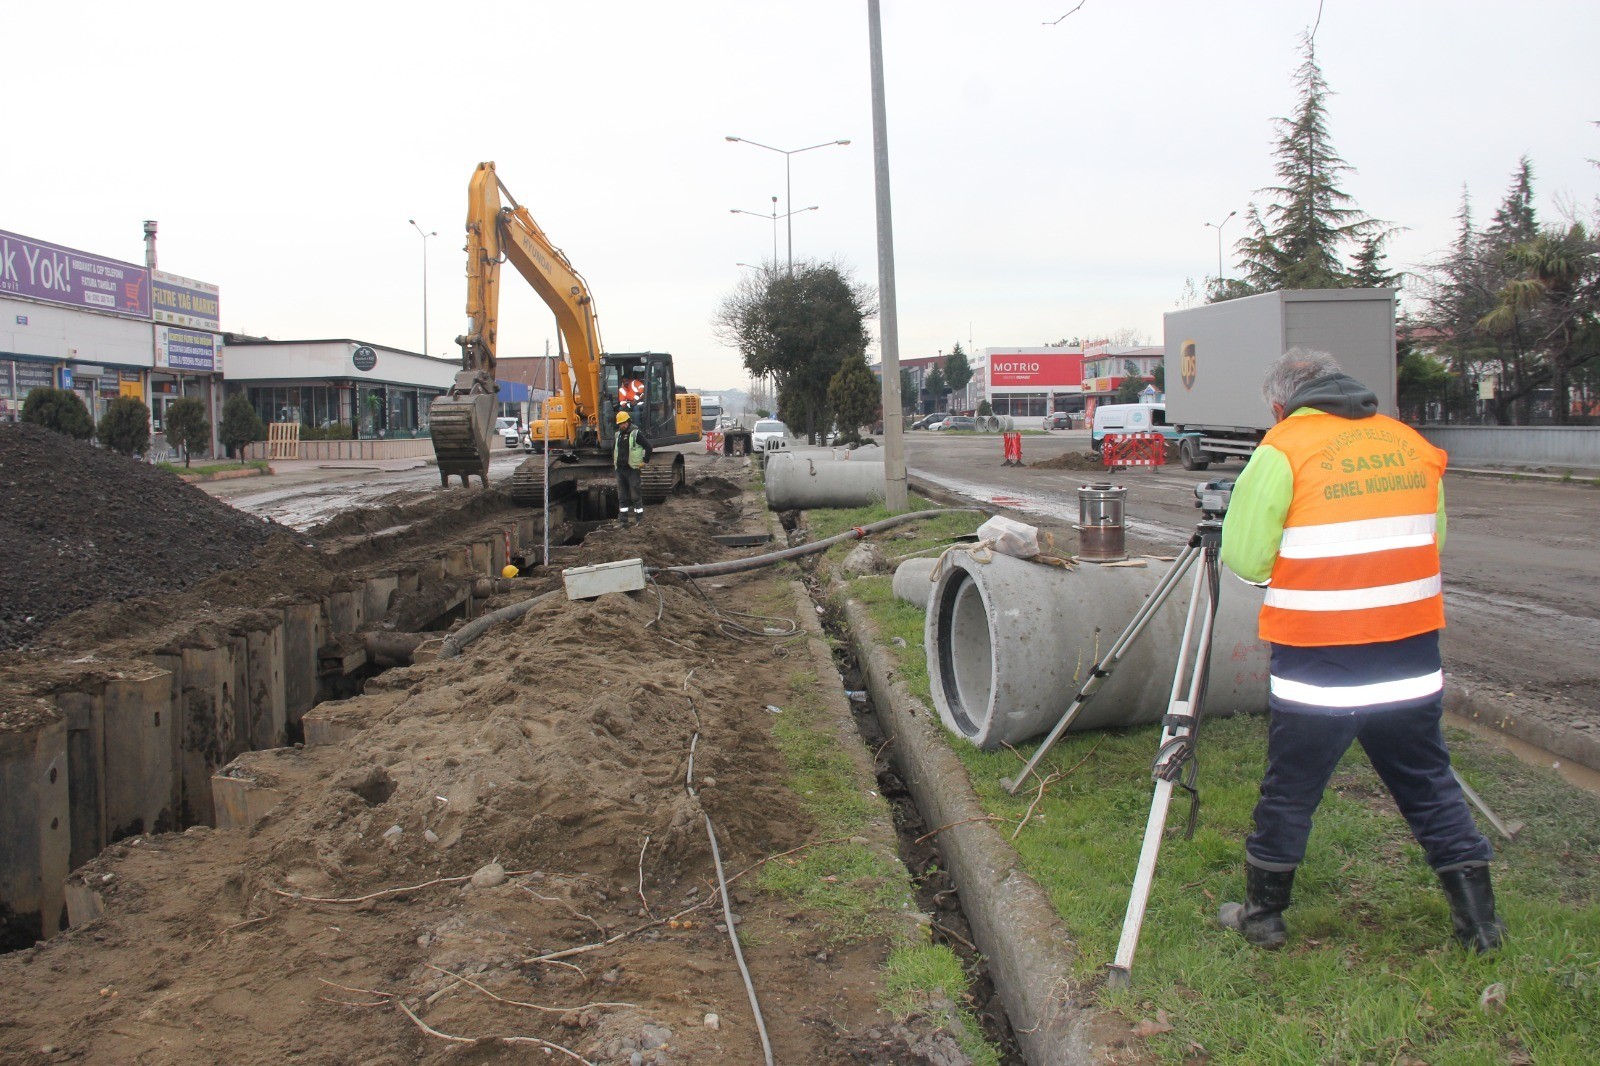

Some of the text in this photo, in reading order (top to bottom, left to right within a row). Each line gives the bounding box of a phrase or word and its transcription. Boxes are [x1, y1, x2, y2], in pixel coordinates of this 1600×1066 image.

[0, 239, 71, 293] k Yok!
[523, 235, 552, 275] HYUNDAI
[177, 291, 192, 311] YAĞ
[192, 295, 218, 316] MARKET
[1341, 450, 1406, 474] SASKİ
[1323, 471, 1427, 500] GENEL MÜDÜRLÜĞÜ
